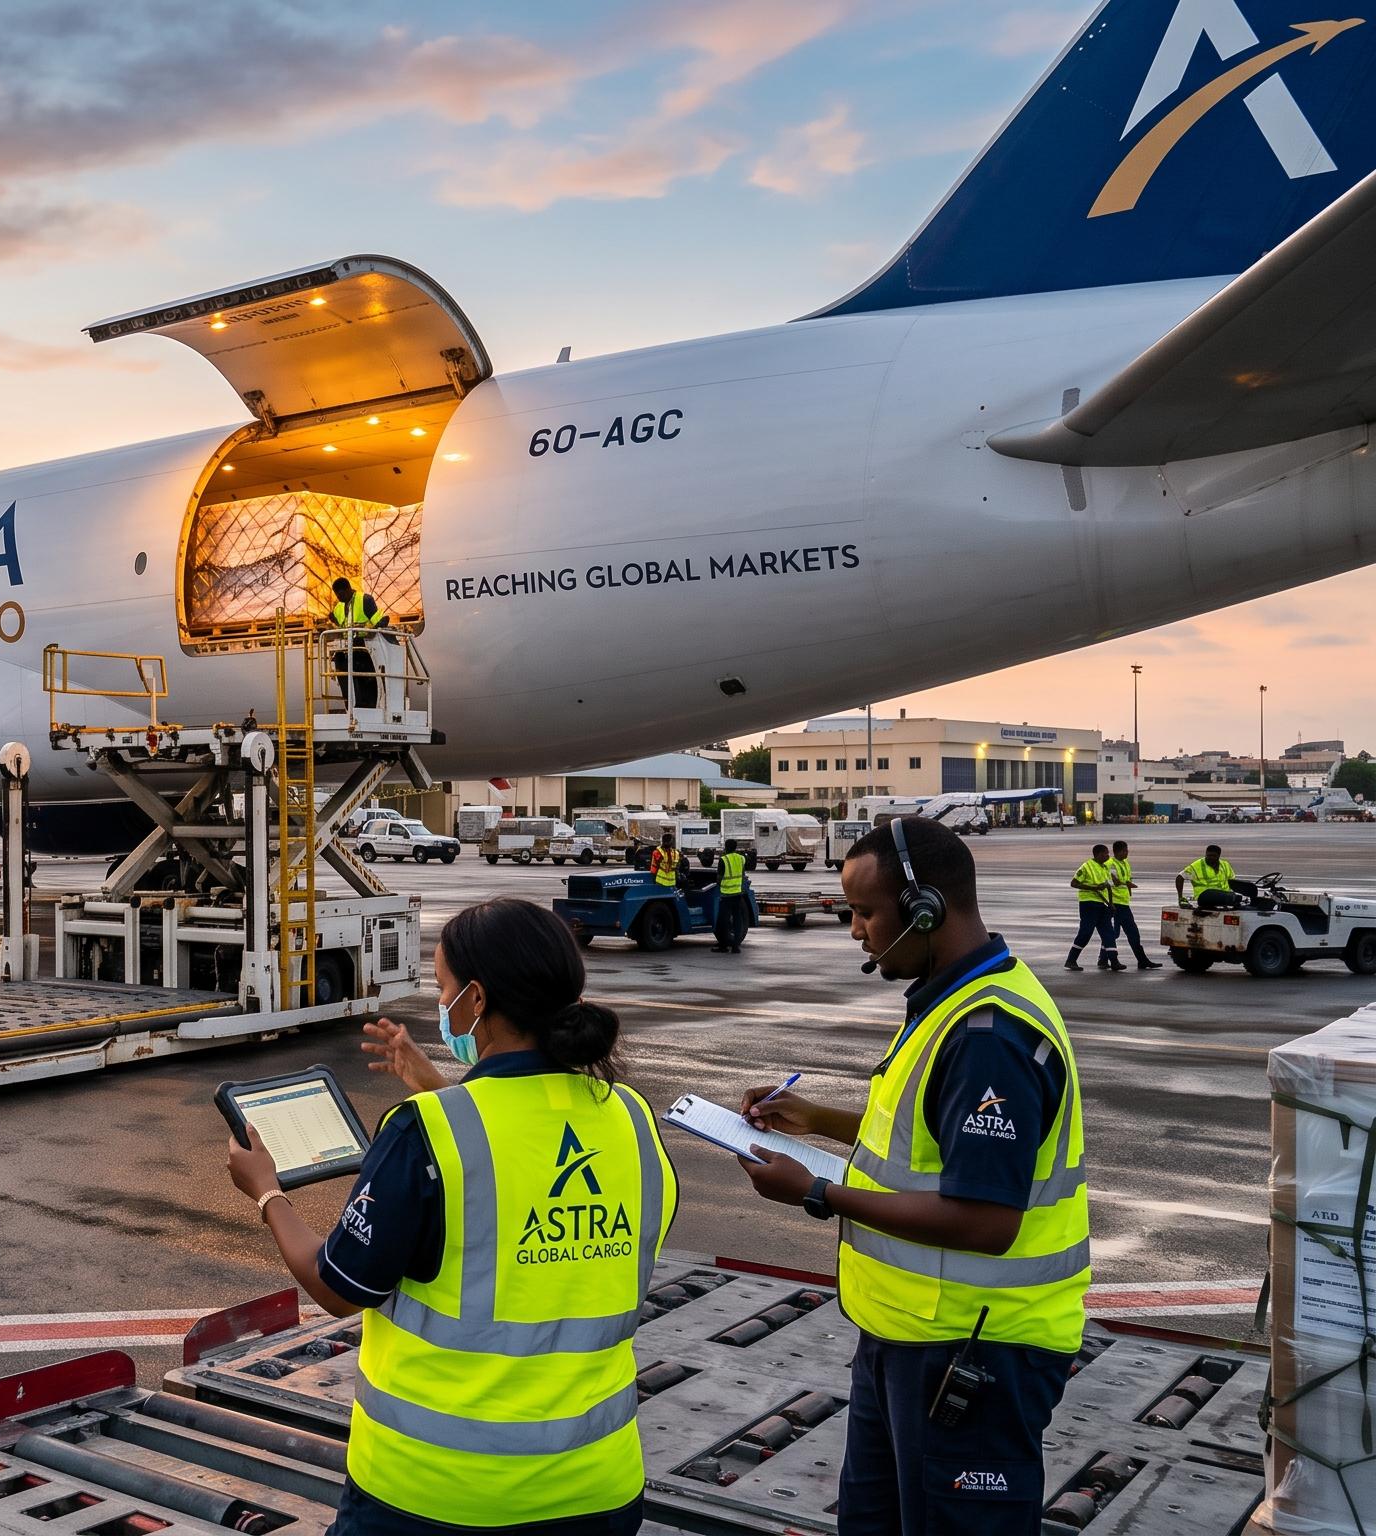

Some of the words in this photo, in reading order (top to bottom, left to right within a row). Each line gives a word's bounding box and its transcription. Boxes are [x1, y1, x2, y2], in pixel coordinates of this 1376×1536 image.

[446, 568, 578, 601] REACHING
[585, 558, 701, 590] GLOBAL
[709, 544, 860, 579] MARKETS
[964, 1113, 1016, 1133] ASTRA
[518, 1201, 633, 1246] ASTRA
[516, 1246, 579, 1265] GLOBAL
[582, 1241, 632, 1260] CARGO
[955, 1471, 1008, 1486] ASTRA
